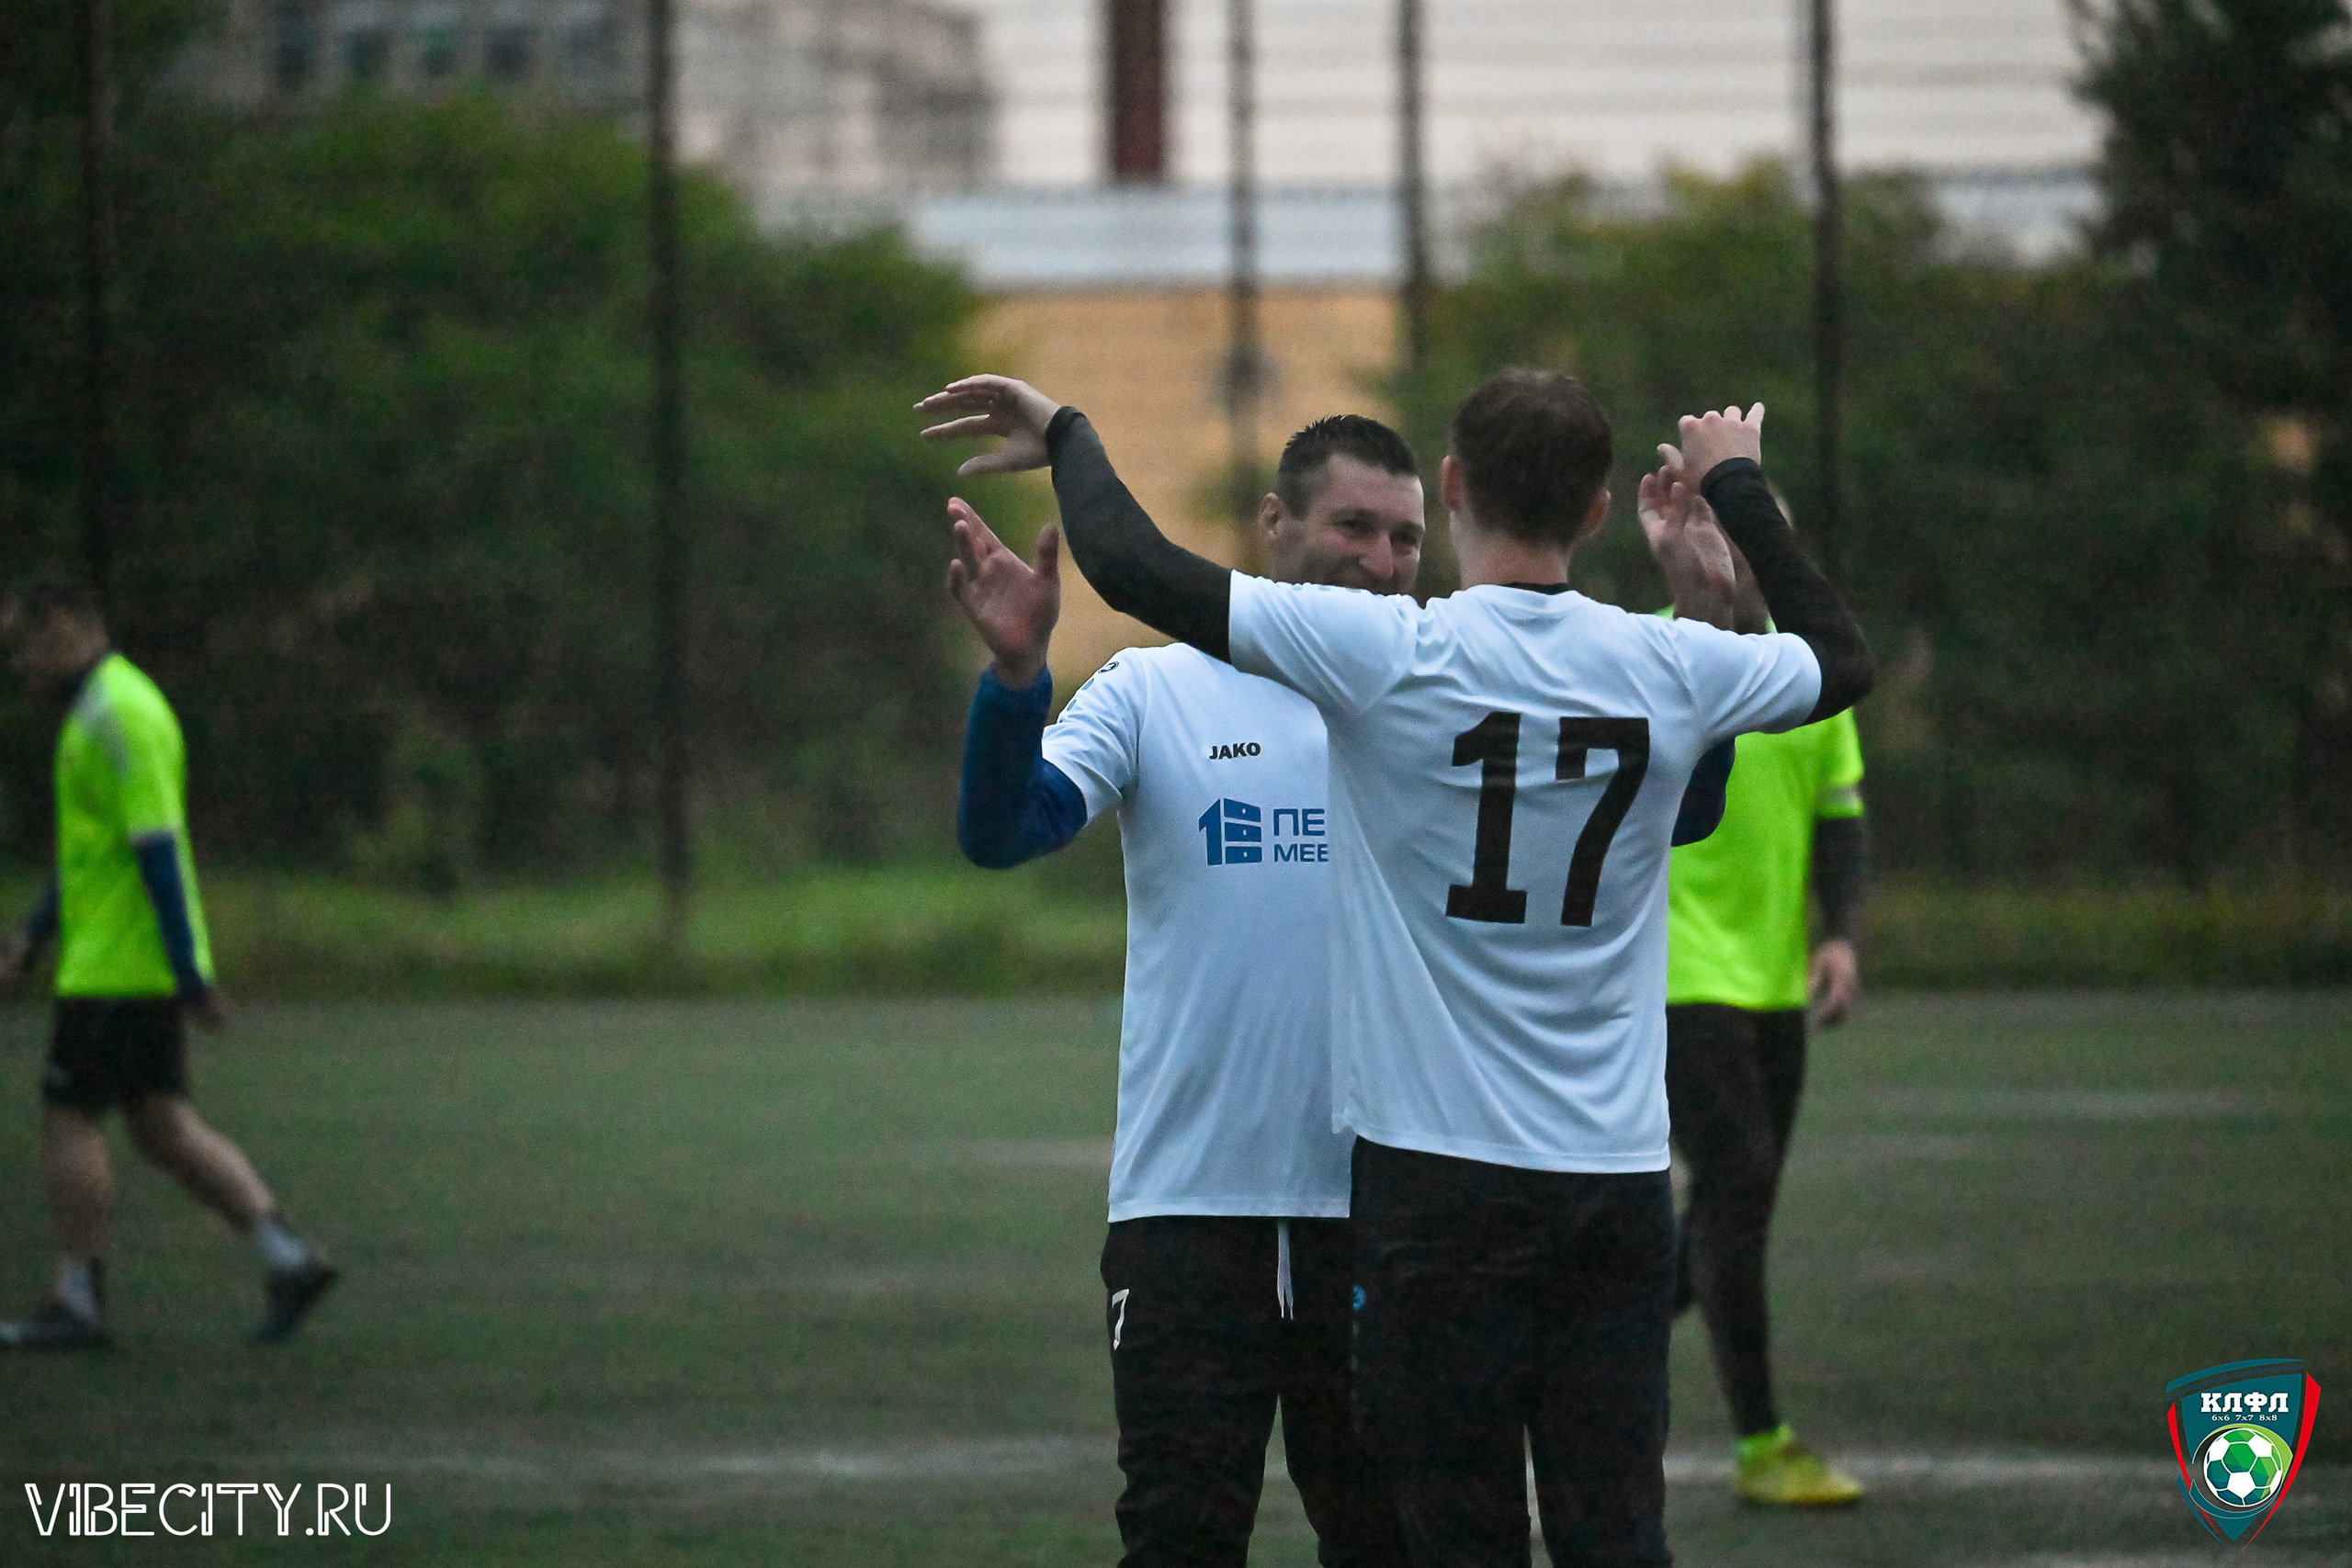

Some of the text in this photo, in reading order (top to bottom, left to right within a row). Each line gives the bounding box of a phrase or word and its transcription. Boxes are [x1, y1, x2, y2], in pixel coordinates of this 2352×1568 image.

[1208, 742, 1261, 759] JAKO
[1446, 711, 1650, 927] 17
[1112, 1289, 1129, 1350] 7
